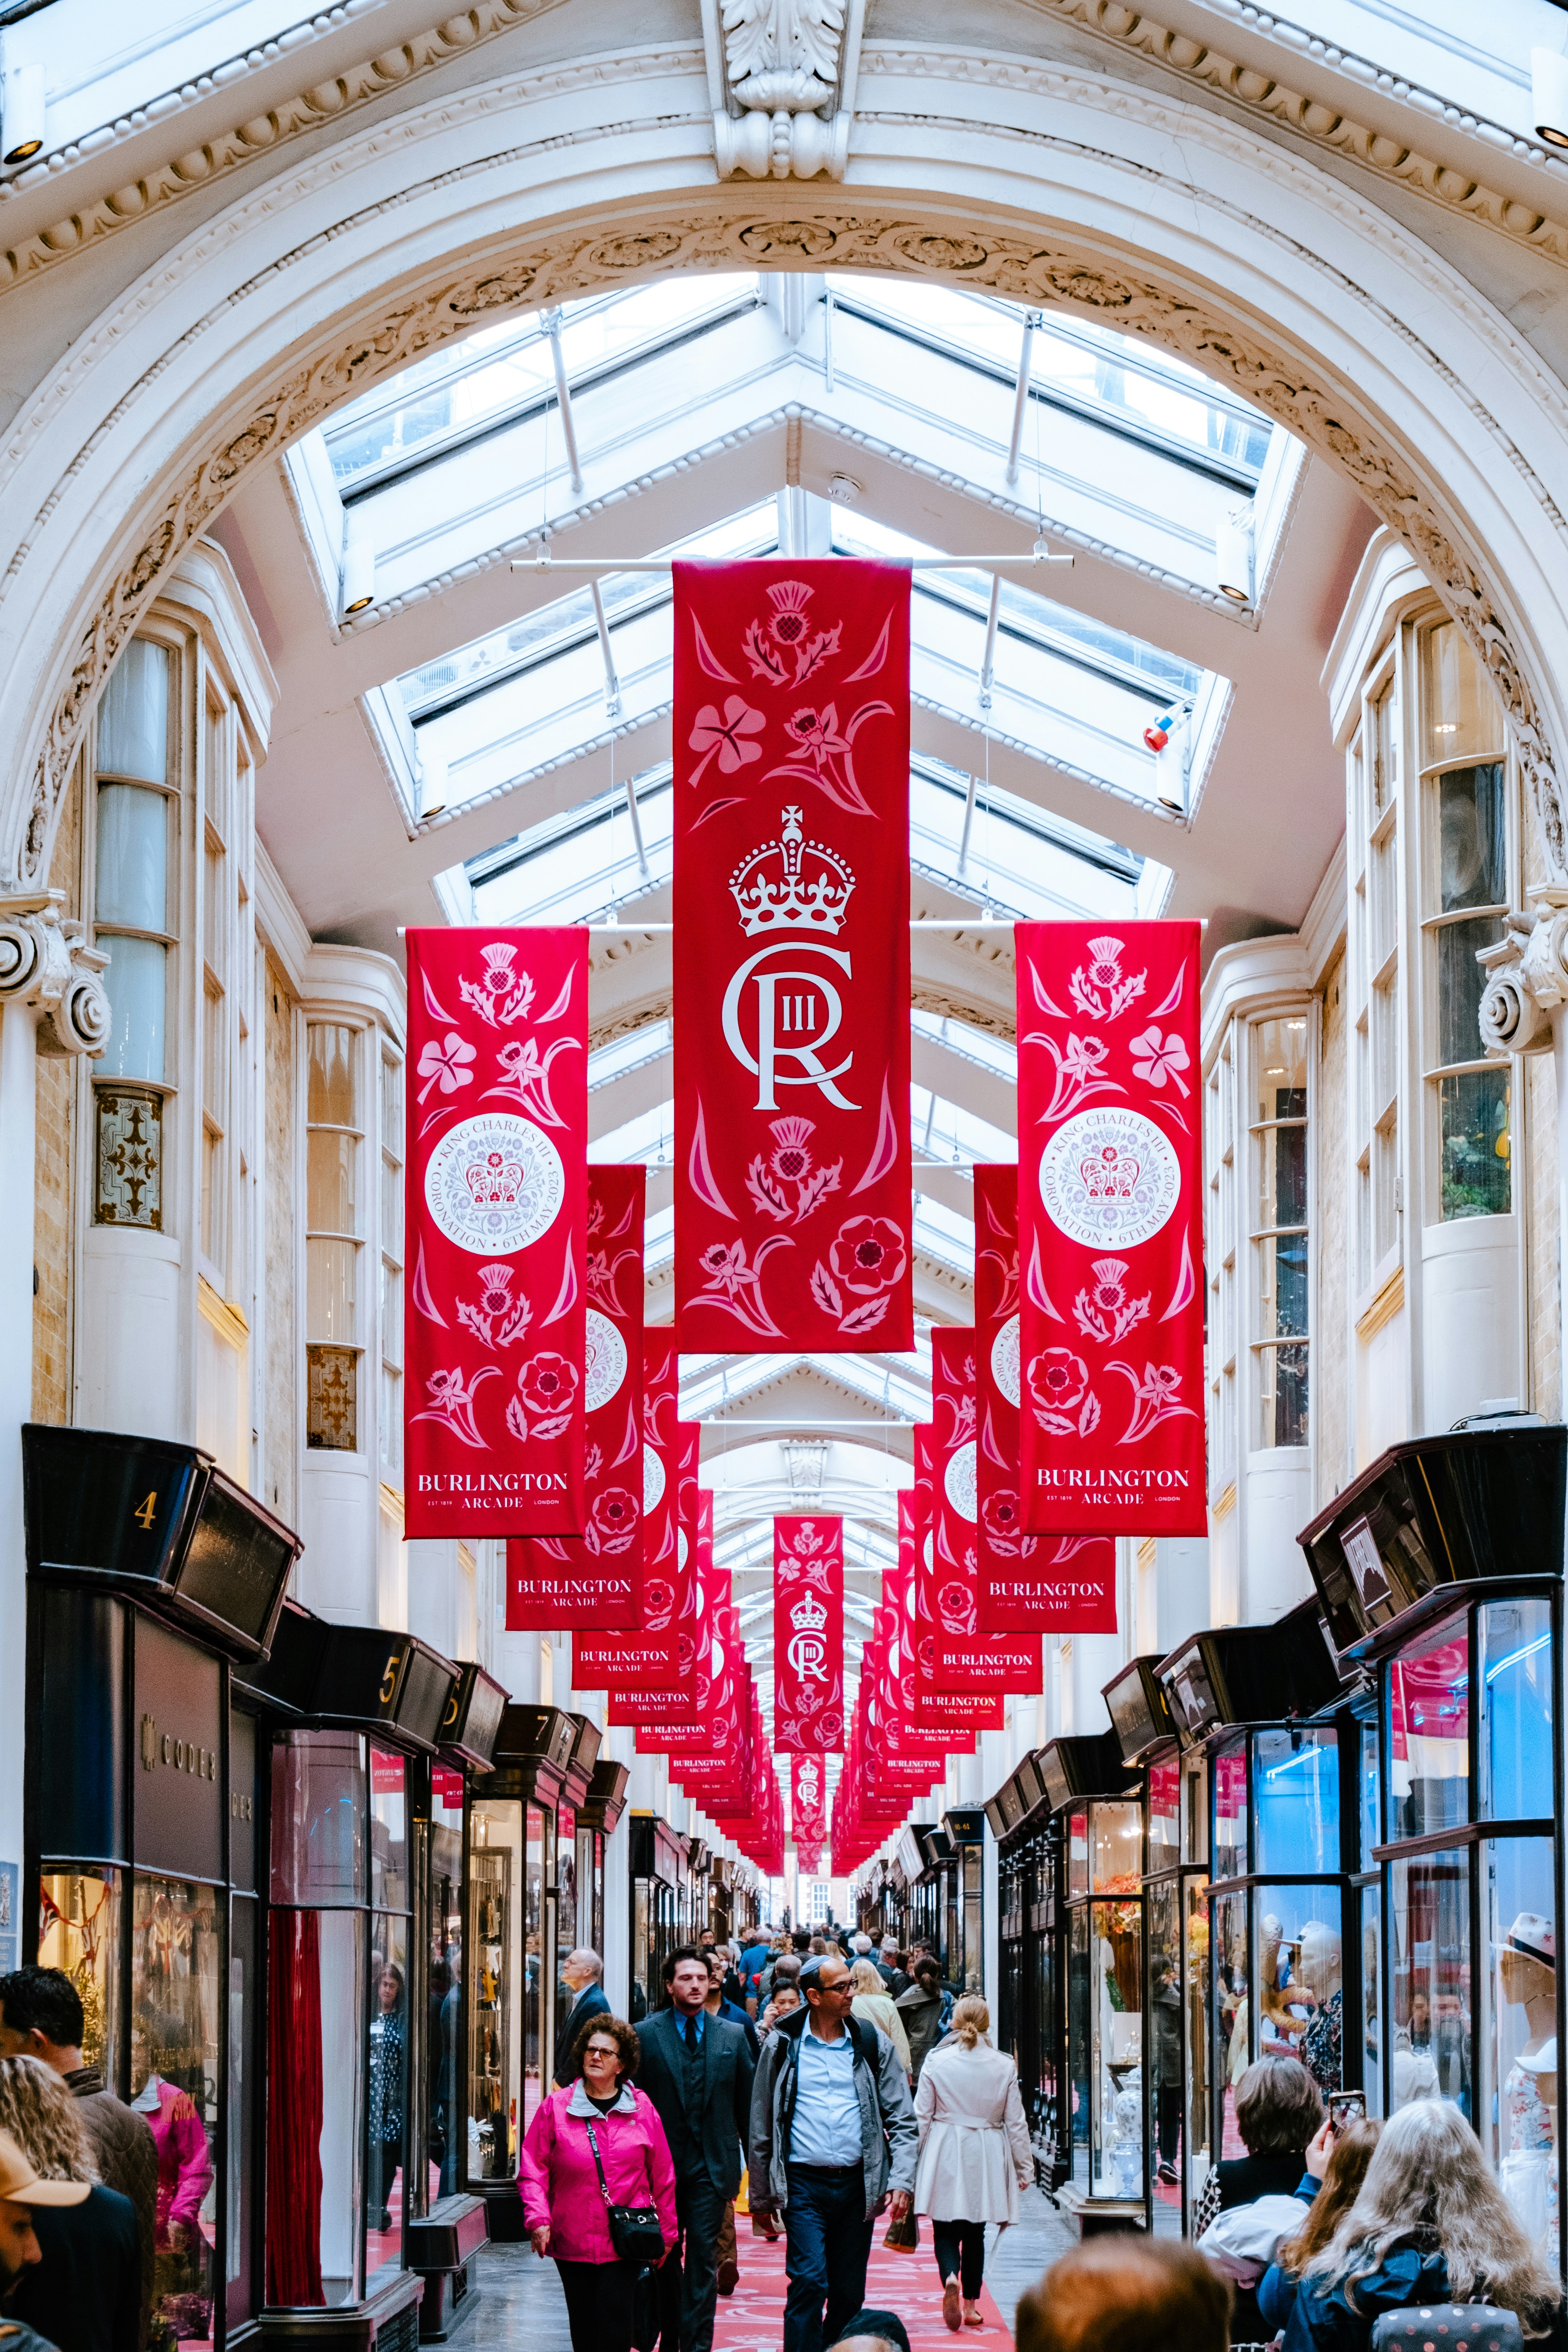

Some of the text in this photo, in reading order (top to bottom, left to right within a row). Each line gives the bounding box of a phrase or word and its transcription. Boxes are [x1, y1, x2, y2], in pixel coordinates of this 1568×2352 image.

[440, 1120, 551, 1159] KING CHARLES III
[1053, 1114, 1167, 1153] KING CHARLES III
[431, 1172, 487, 1249] CORONATION
[503, 1171, 559, 1248] 6TH MAY 2023
[1045, 1166, 1102, 1243] CORONATION
[1119, 1166, 1175, 1243] 6TH MAY 2023
[605, 1328, 617, 1340] III
[586, 1350, 623, 1407] TH MAY 2023
[995, 1351, 1020, 1401] CORONAT
[953, 1447, 971, 1466] KING
[418, 1473, 568, 1491] BURLINGTON
[1038, 1468, 1189, 1487] BURLINGTON
[462, 1497, 523, 1508] ARCADE
[645, 1491, 658, 1510] MAY
[948, 1473, 977, 1518] CORONATIO
[1081, 1493, 1144, 1505] ARCADE
[135, 1491, 157, 1529] 4
[518, 1579, 631, 1593] BURLINGTON
[990, 1582, 1104, 1596] BURLINGTON
[551, 1597, 598, 1606] ARCADE
[1023, 1601, 1070, 1609] ARCADE
[580, 1650, 669, 1661] BURLINGTON
[943, 1654, 1033, 1665] BURLINGTON
[379, 1656, 400, 1703] 5
[615, 1693, 690, 1702] BURLINGTON
[922, 1695, 997, 1707] BURLINGTON
[641, 1725, 706, 1733] BURLINGTON
[887, 1759, 941, 1768] BURLINGTON
